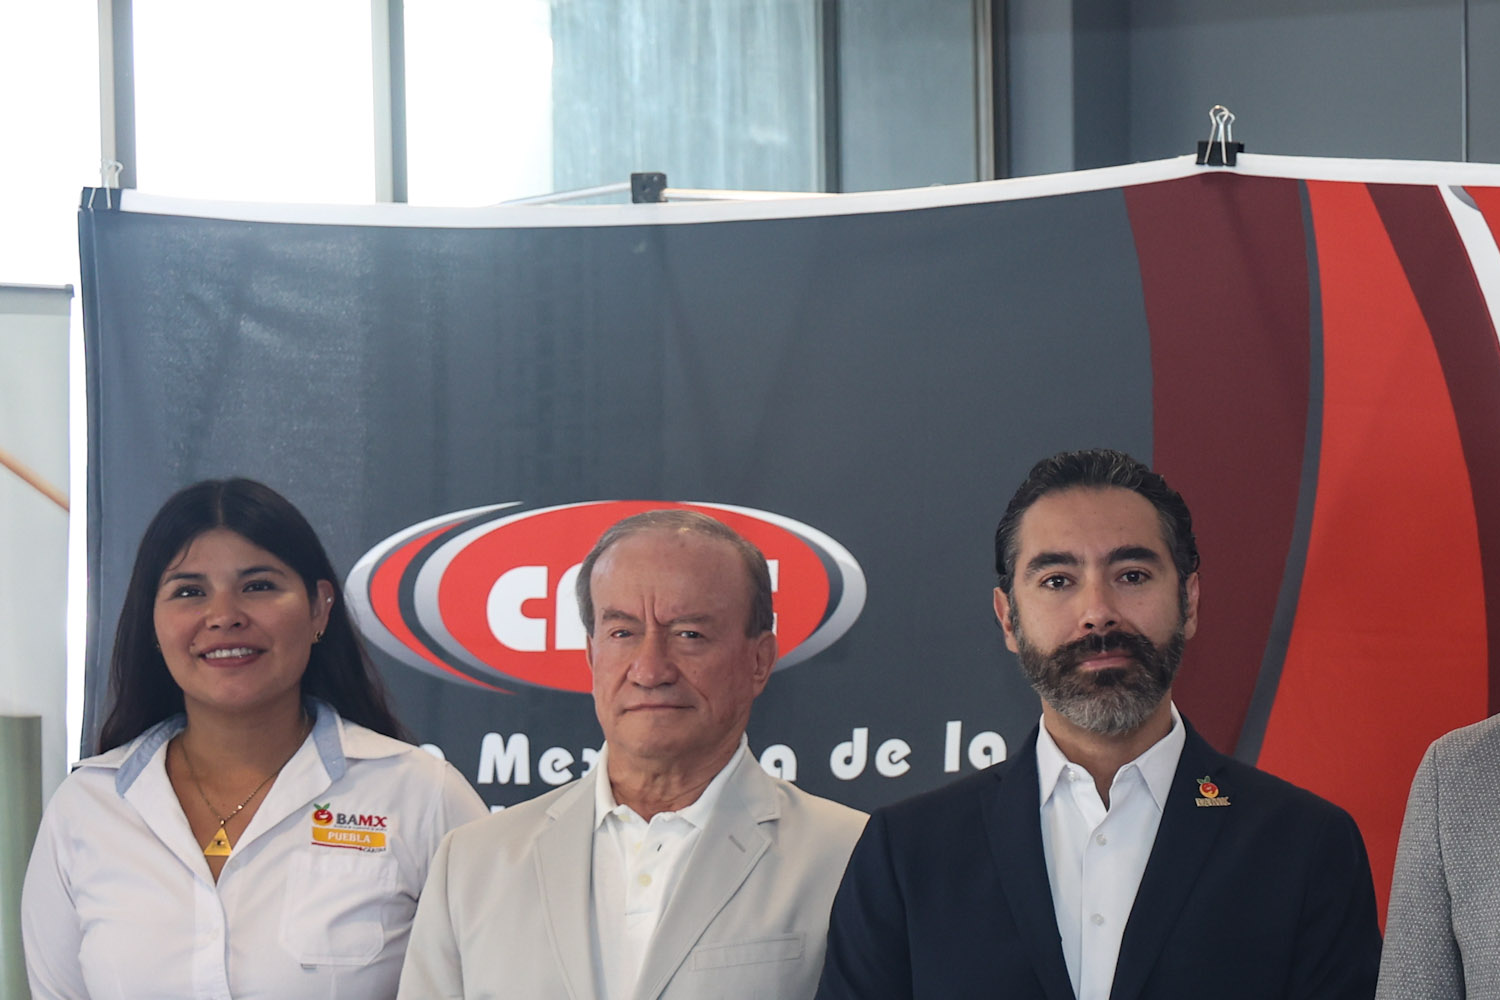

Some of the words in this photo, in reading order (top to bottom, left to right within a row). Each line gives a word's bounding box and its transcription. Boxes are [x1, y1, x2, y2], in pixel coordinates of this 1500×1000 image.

[830, 727, 912, 780] de
[944, 720, 1007, 770] la
[336, 813, 387, 828] BAMX
[328, 831, 371, 844] PUEBLA
